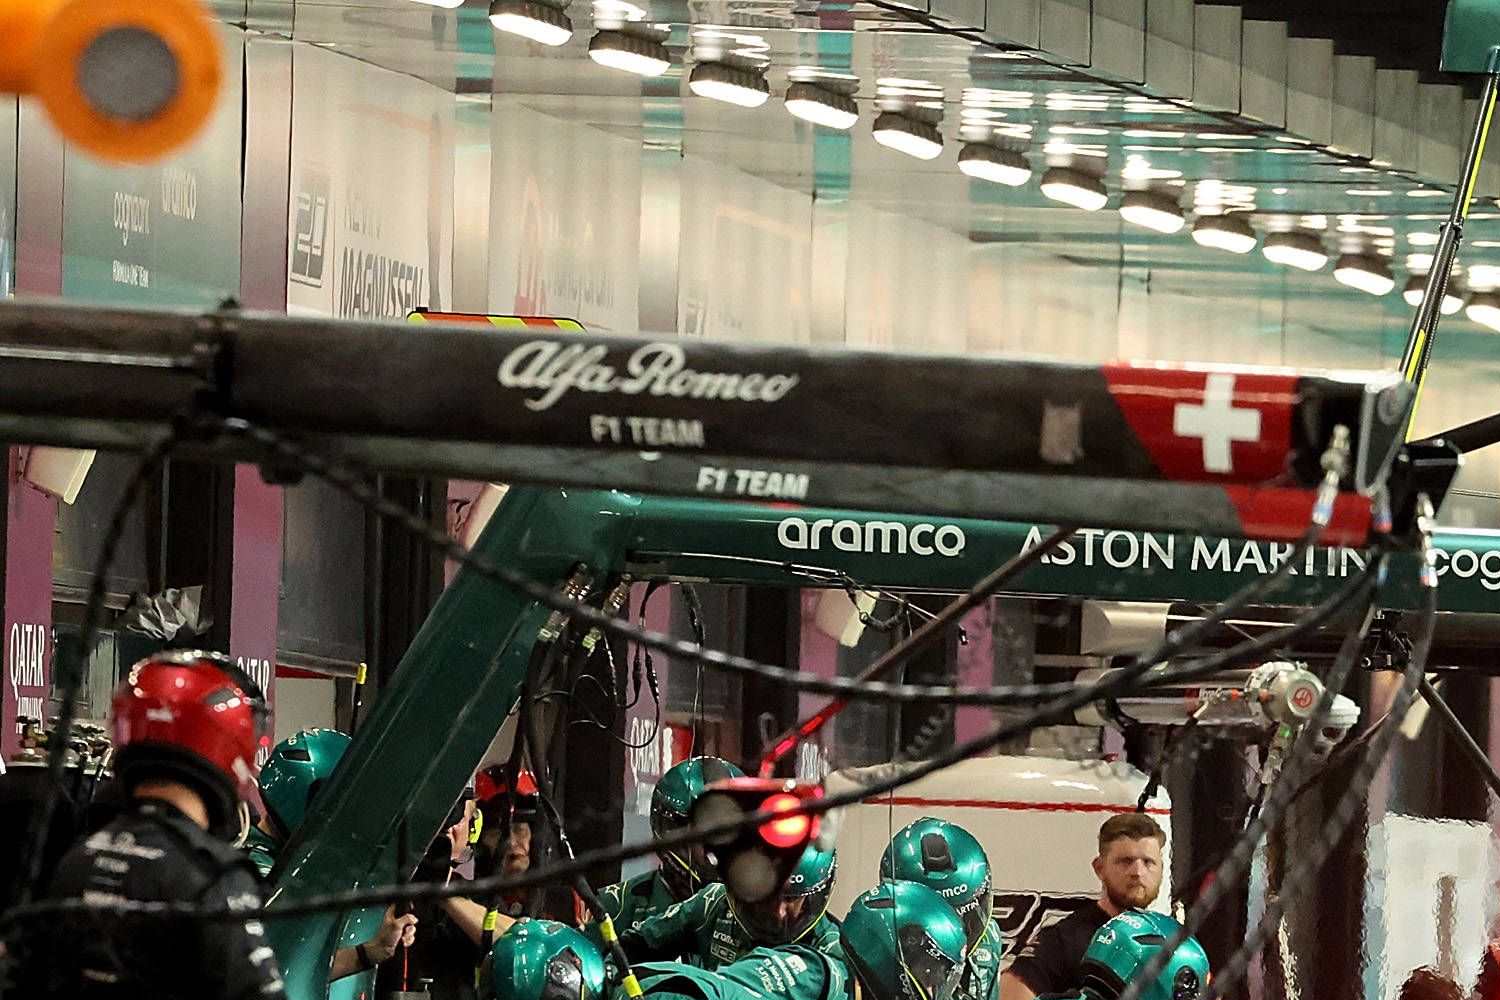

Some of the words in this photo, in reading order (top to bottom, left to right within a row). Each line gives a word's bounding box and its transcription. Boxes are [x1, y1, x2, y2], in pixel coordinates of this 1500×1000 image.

[497, 340, 619, 411] Alfa
[620, 341, 800, 403] Romeo
[590, 414, 621, 444] F1
[625, 416, 705, 448] TEAM
[696, 466, 728, 494] F1
[734, 468, 810, 500] TEAM
[777, 517, 967, 558] aramco
[1018, 526, 1174, 571] ASTON
[10, 622, 45, 701] QATAR
